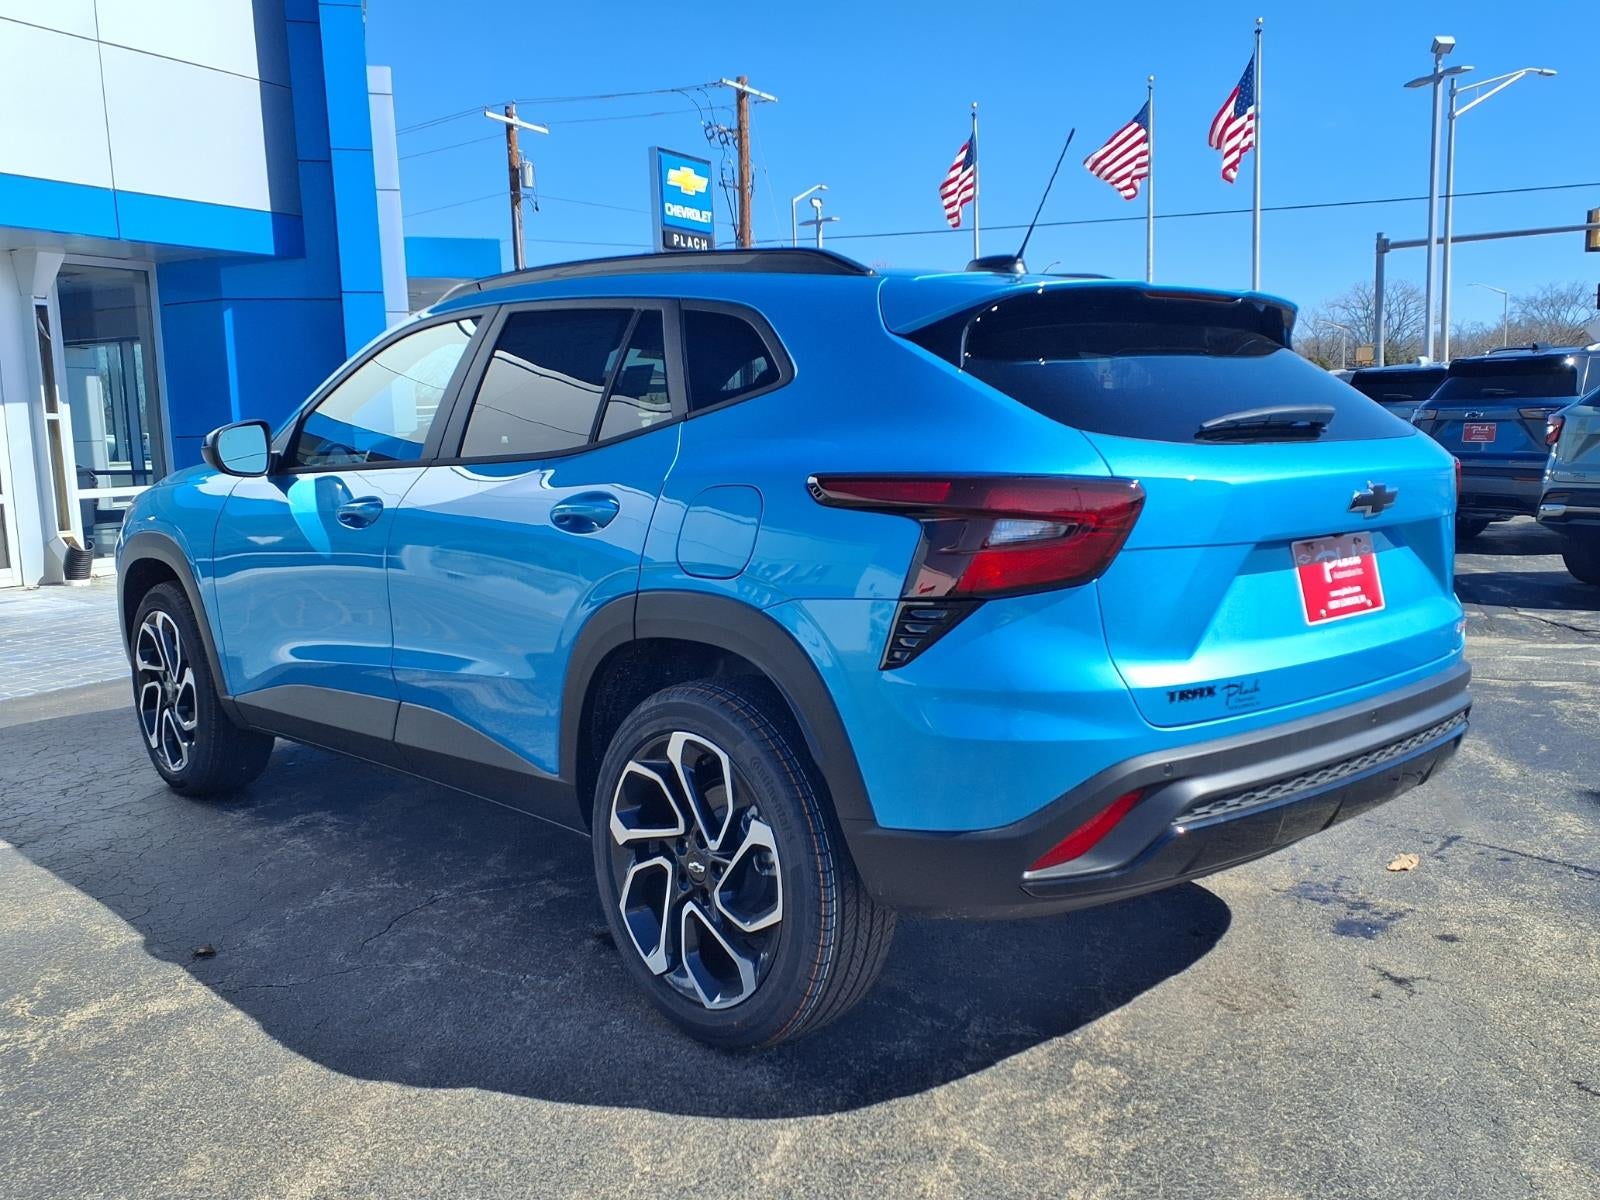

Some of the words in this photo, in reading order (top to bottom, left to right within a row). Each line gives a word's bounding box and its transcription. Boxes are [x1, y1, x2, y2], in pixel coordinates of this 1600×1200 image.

[665, 203, 712, 223] CHEVROLET
[673, 234, 708, 250] PLACH
[1167, 685, 1216, 703] TRAX
